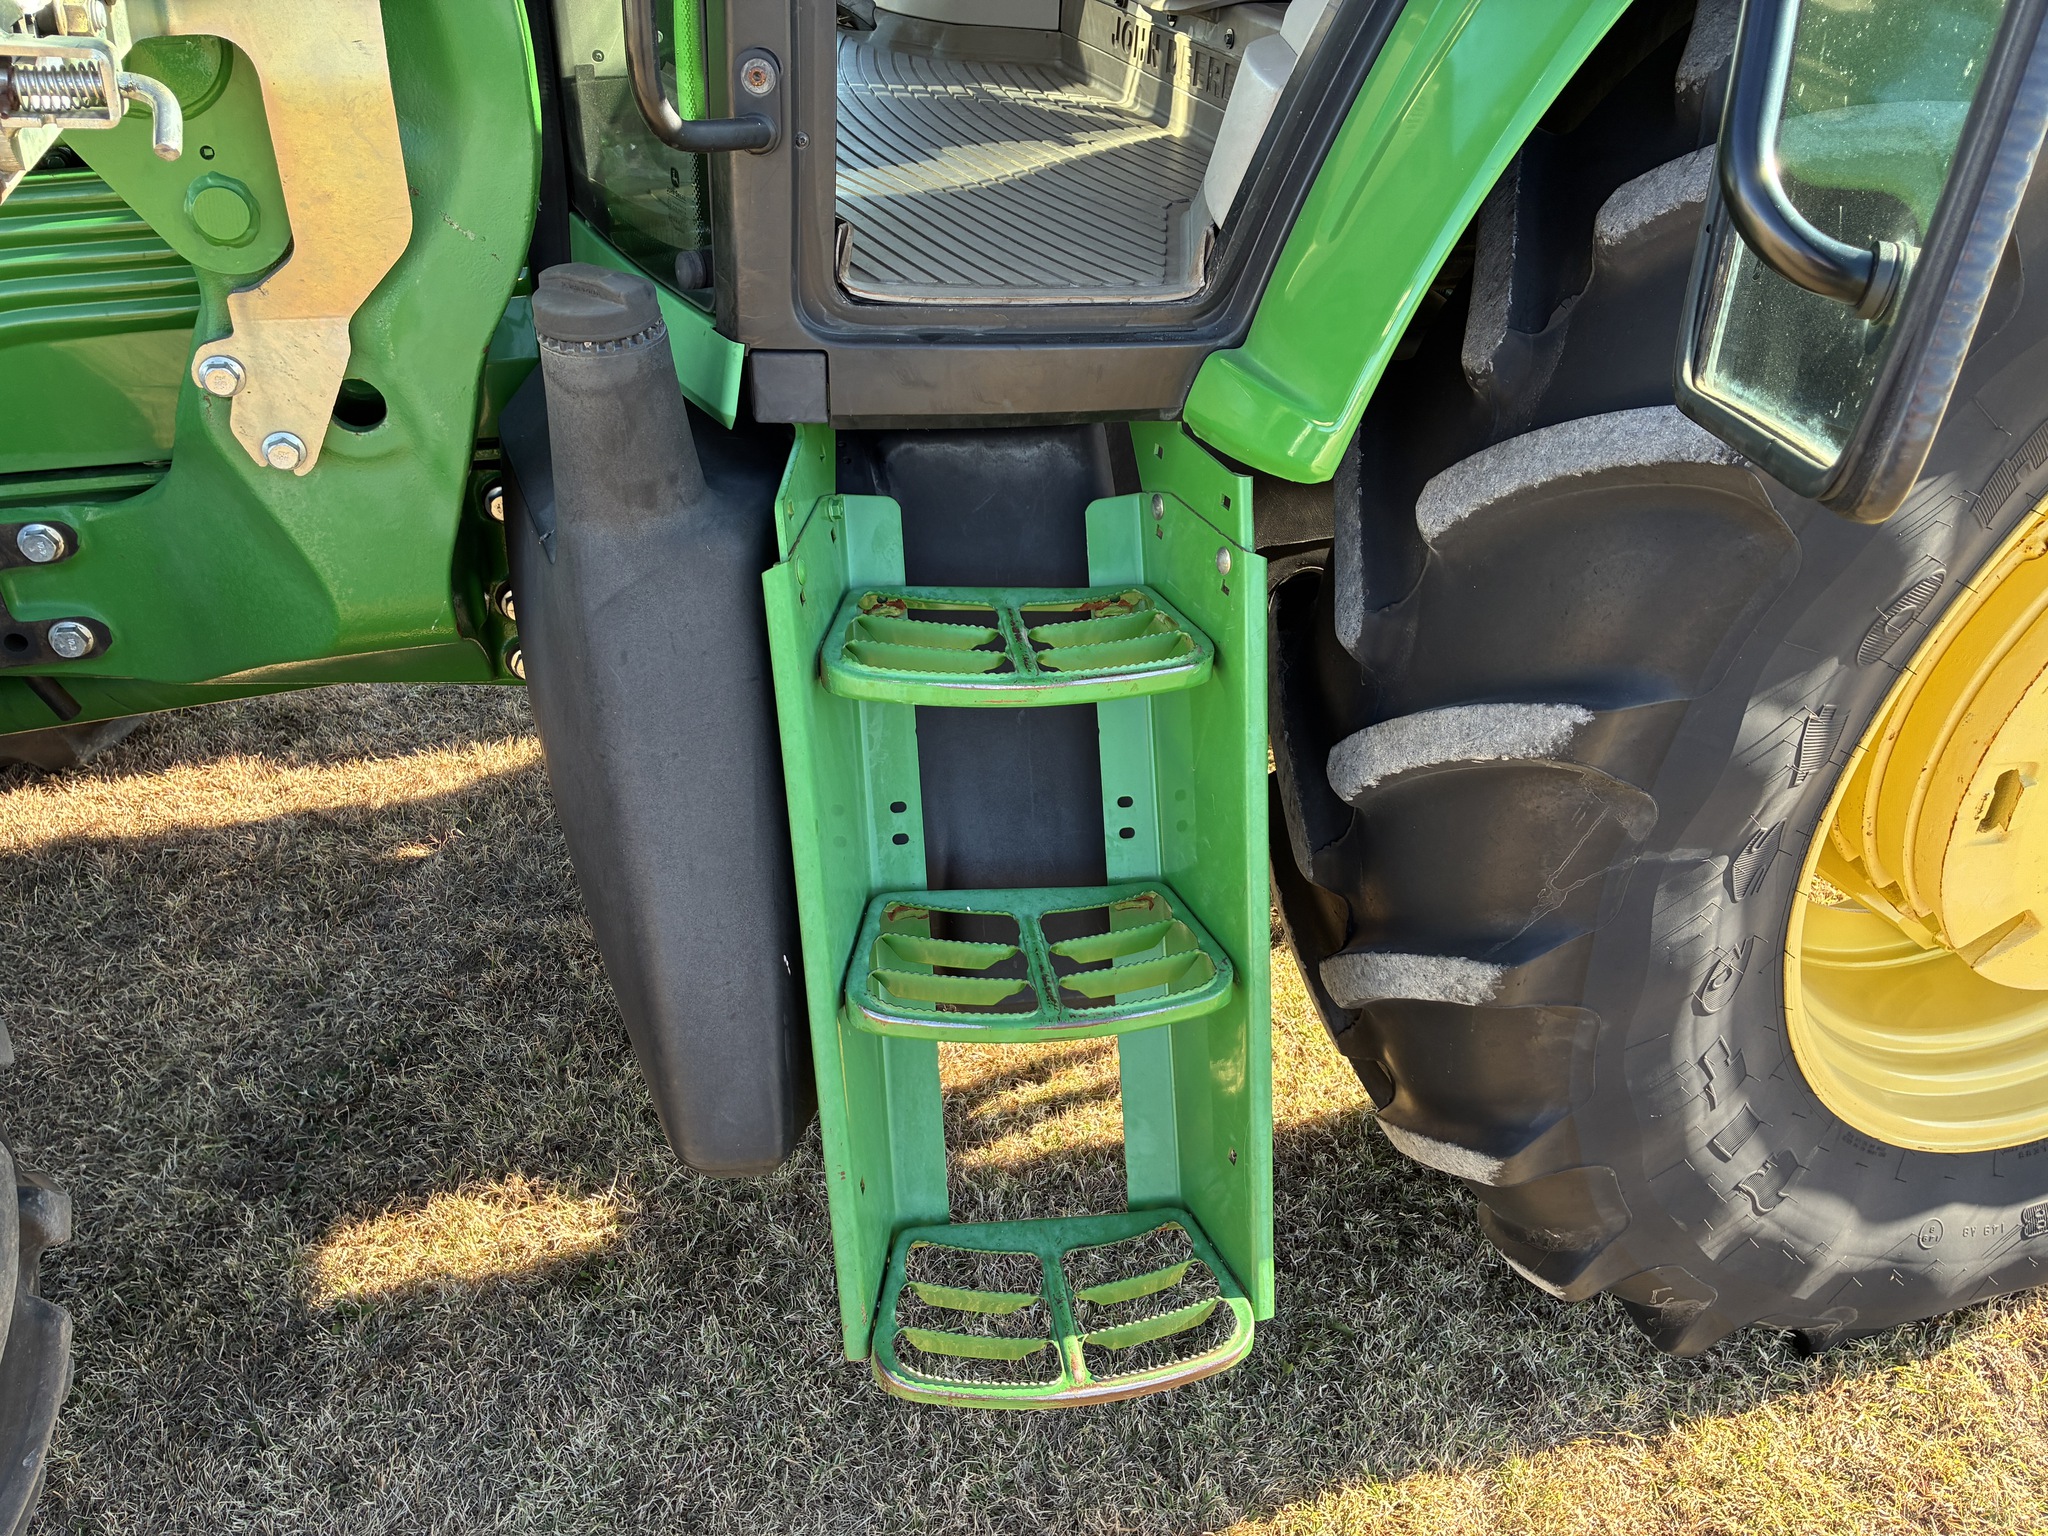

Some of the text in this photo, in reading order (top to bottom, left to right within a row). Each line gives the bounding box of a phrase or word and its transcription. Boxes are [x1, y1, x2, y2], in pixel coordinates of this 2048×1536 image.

[1111, 16, 1239, 100] JOHN DEERE
[1697, 419, 2048, 1214] Fireston
